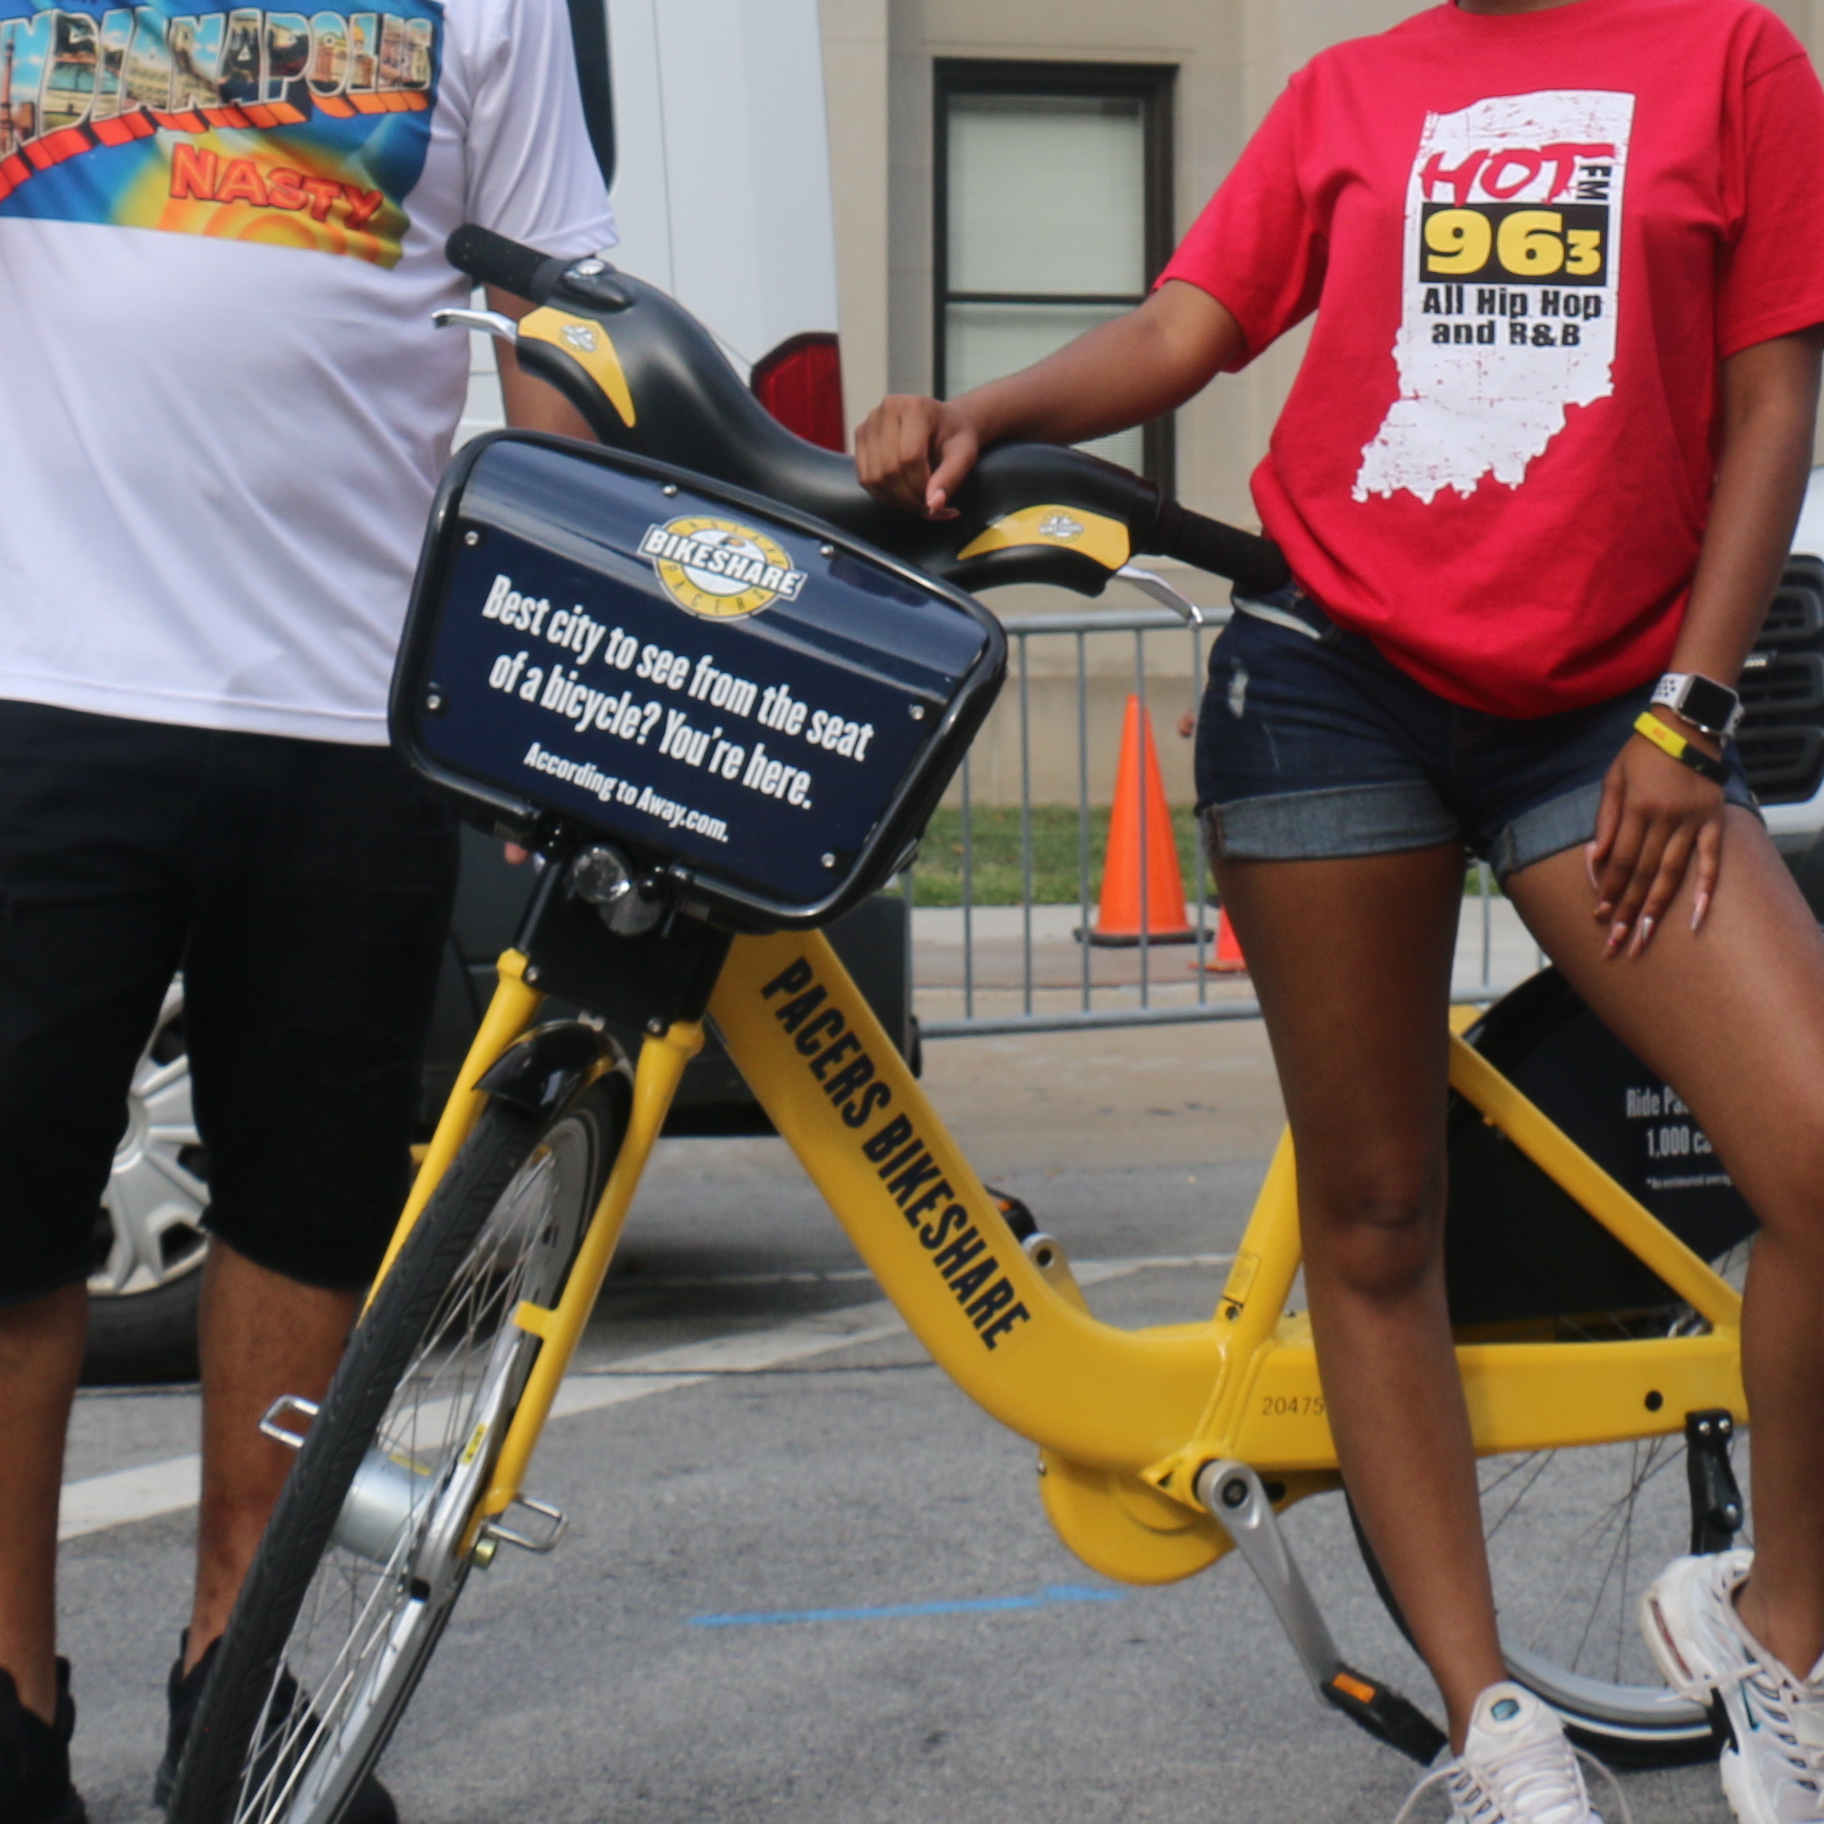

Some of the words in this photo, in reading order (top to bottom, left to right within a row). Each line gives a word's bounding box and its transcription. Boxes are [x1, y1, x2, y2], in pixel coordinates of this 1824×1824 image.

[169, 142, 383, 231] NASTY
[1419, 142, 1616, 208] HOT
[1577, 164, 1611, 201] FM
[1423, 286, 1465, 317] All
[1477, 287, 1529, 321] Hip
[1541, 290, 1602, 321] Hop
[1432, 319, 1496, 346] and
[1509, 321, 1581, 348] R&B
[644, 527, 802, 595] BIKESHARE
[482, 573, 551, 637] Best
[546, 604, 607, 665] city
[604, 626, 639, 671] to
[635, 643, 691, 691] see
[687, 654, 758, 718] from
[757, 683, 808, 736] the
[805, 709, 875, 763] seat
[488, 650, 529, 694] of
[519, 666, 544, 703] a
[539, 663, 663, 746] bicycle?
[658, 708, 746, 780] You're
[742, 742, 812, 810] here.
[523, 742, 618, 802] According
[615, 779, 639, 806] to
[635, 786, 730, 844] Away.com.
[761, 956, 892, 1129] PACERS
[861, 1113, 1031, 1352] BIKESHARE
